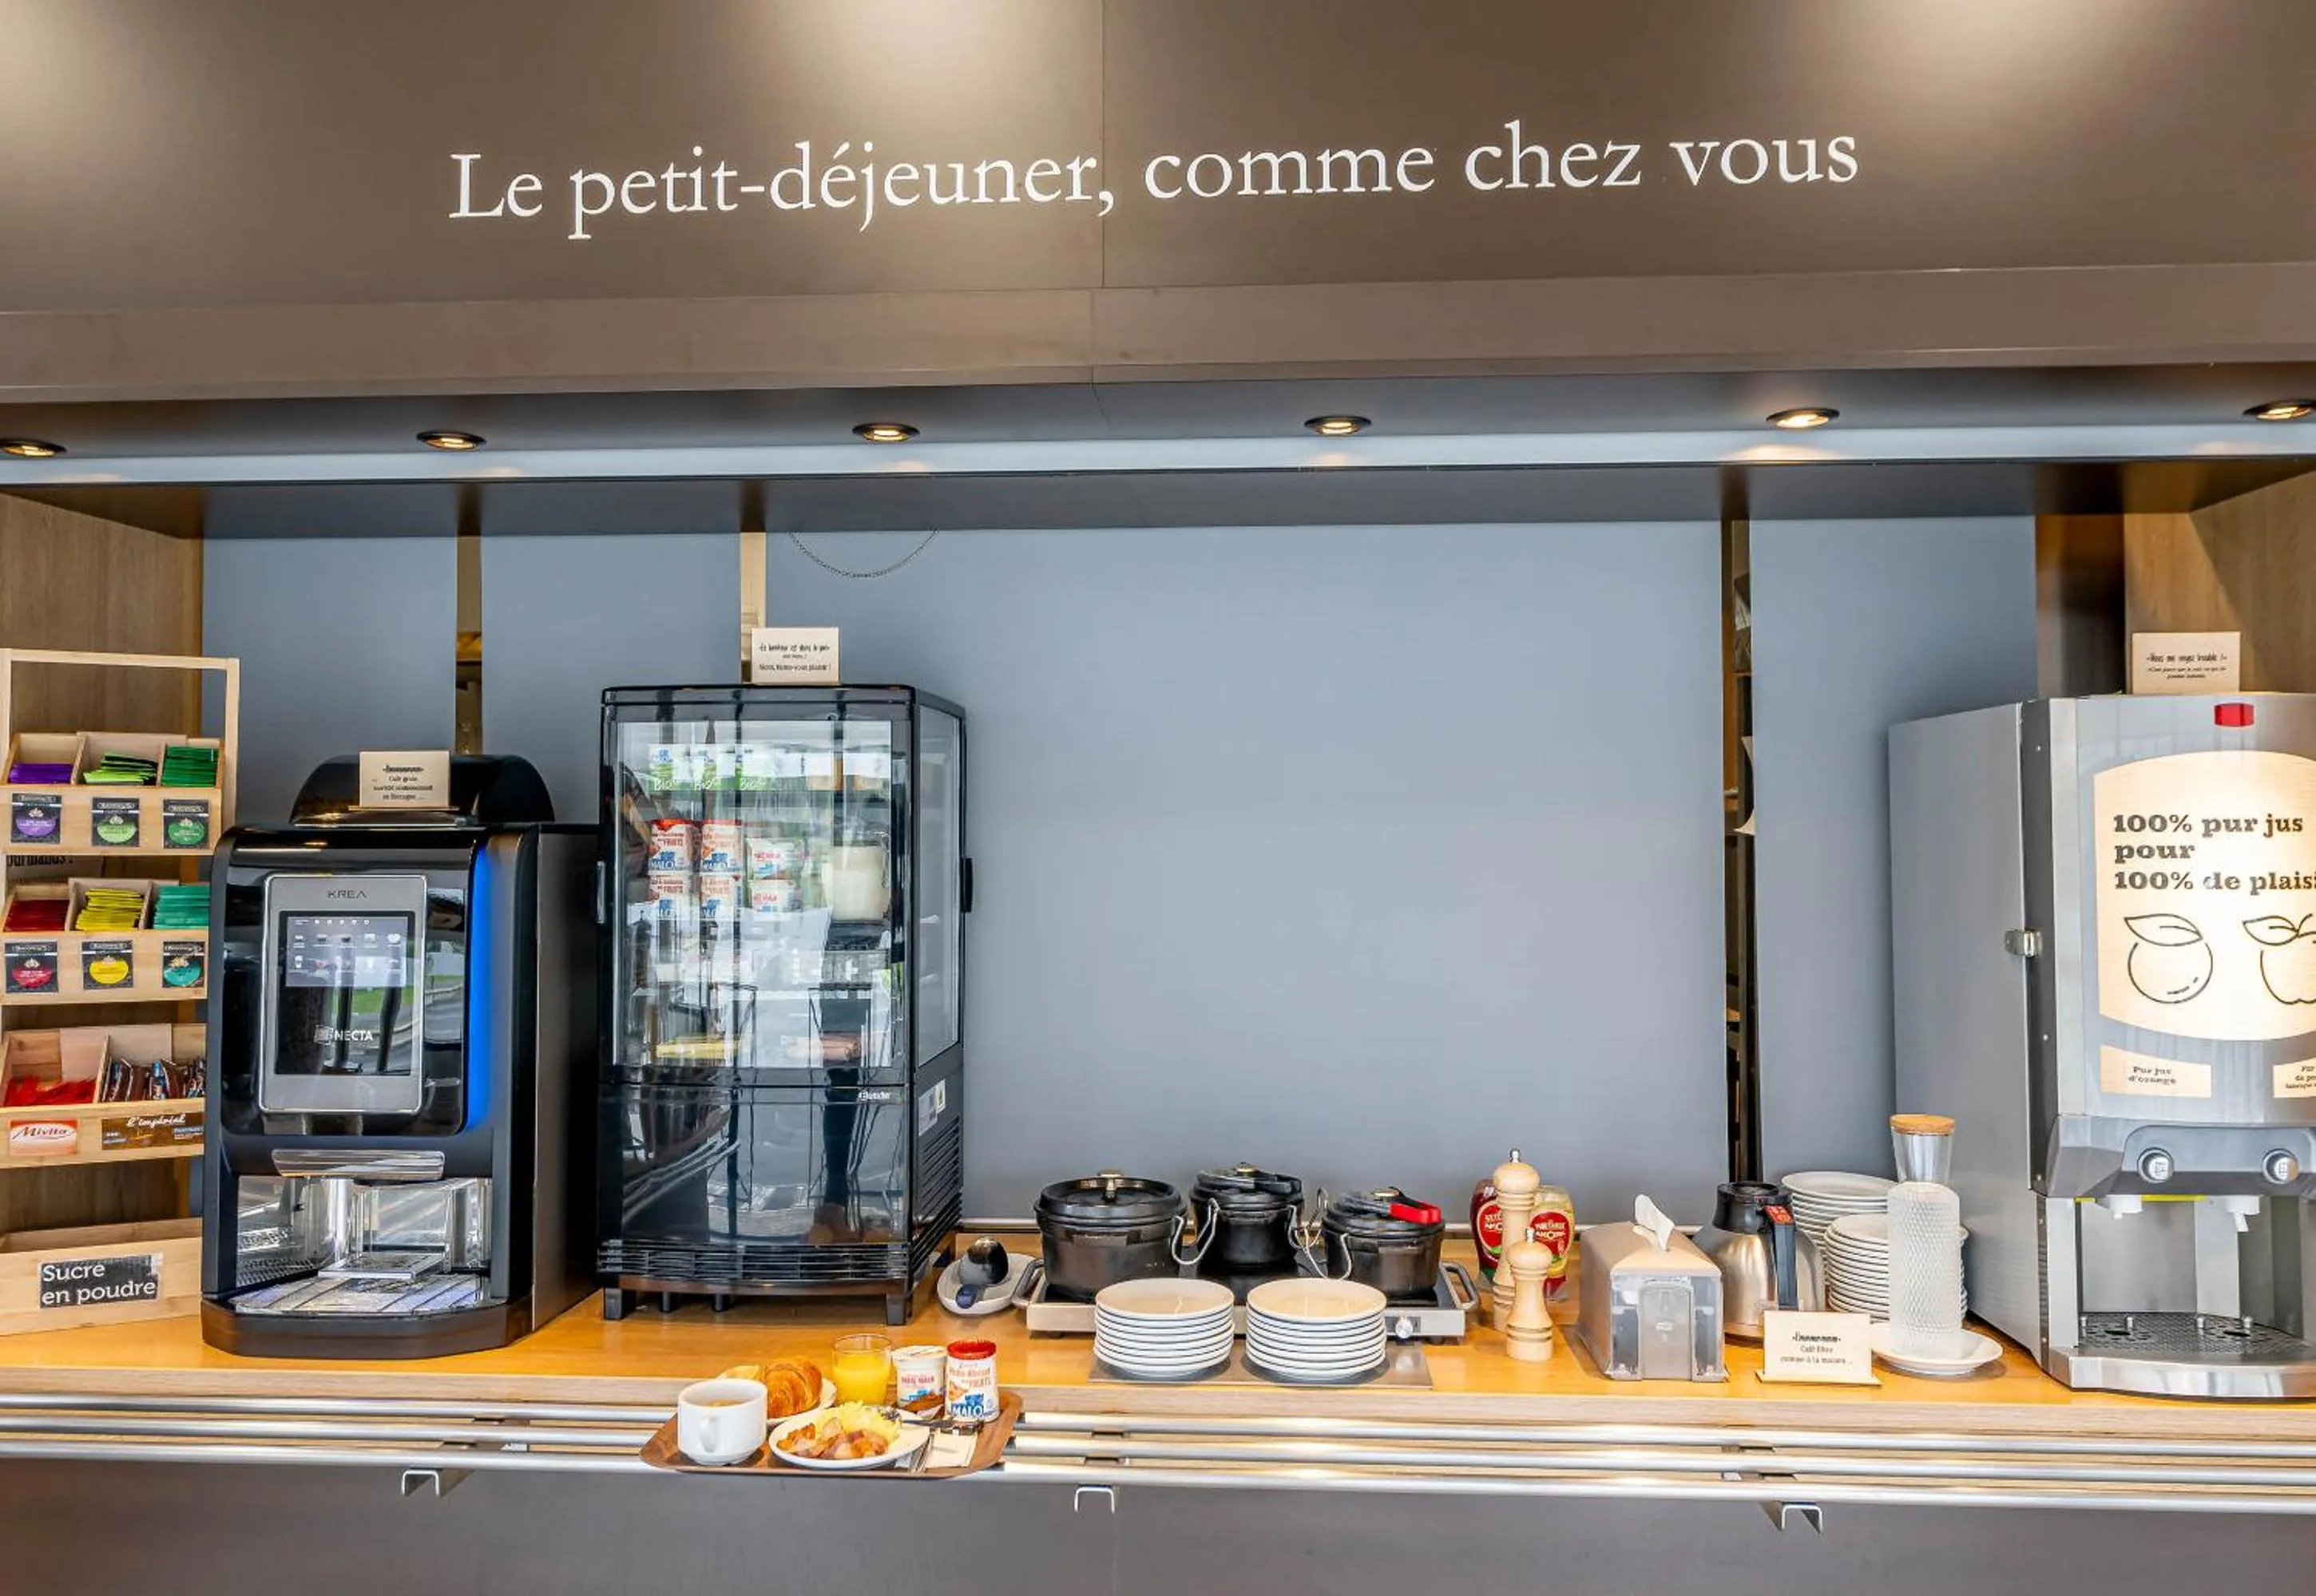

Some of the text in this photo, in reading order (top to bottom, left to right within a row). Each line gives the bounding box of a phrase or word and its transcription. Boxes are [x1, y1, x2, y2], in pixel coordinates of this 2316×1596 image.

[449, 119, 1859, 240] Le petit-déjeuner, comme chez vous
[2113, 814, 2303, 838] 100% pur jus
[2115, 845, 2195, 864] pour
[2115, 870, 2316, 896] 100% de plais
[327, 890, 367, 899] KREA
[42, 1262, 105, 1282] Sucre
[42, 1280, 157, 1305] en poudre
[950, 1404, 984, 1417] MALO
